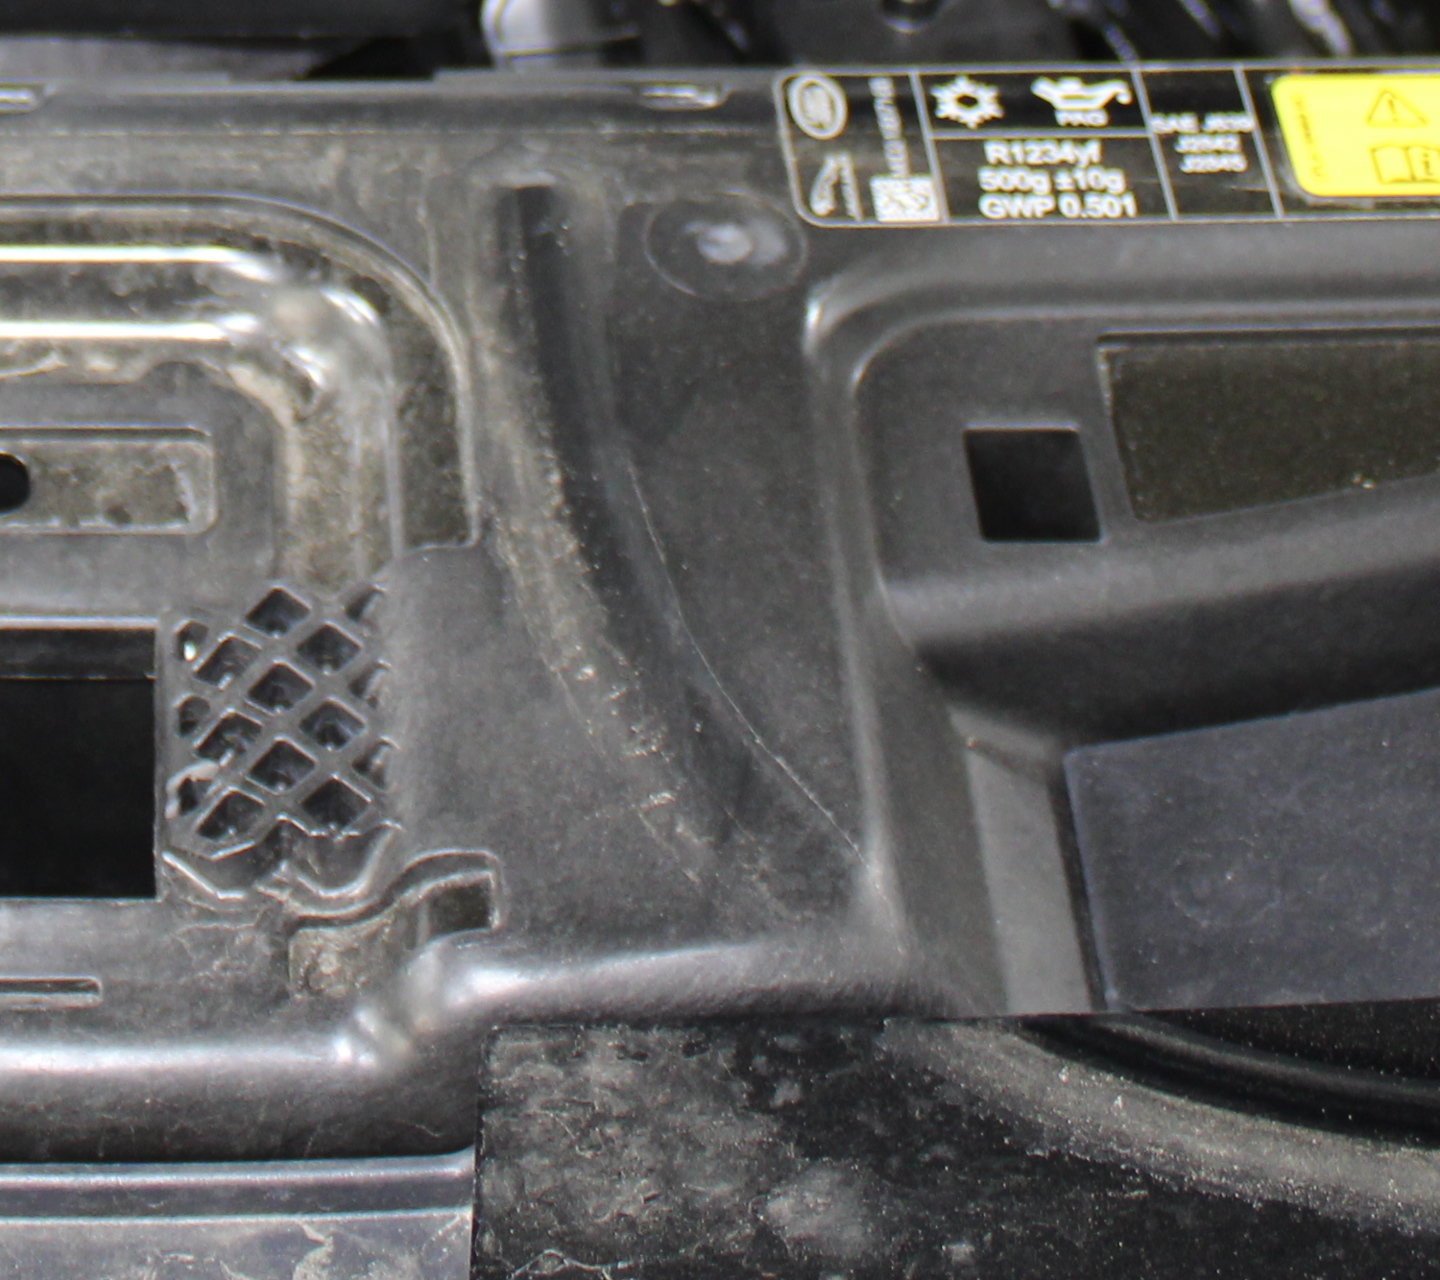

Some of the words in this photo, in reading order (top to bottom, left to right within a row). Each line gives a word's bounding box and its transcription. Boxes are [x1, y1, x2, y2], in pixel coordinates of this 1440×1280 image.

[1150, 112, 1199, 133] SAE
[983, 138, 1102, 168] R1234yf
[977, 166, 1052, 195] 500g
[1053, 166, 1127, 195] ±10g
[978, 192, 1056, 219] GWP
[1058, 191, 1138, 218] 0.501
